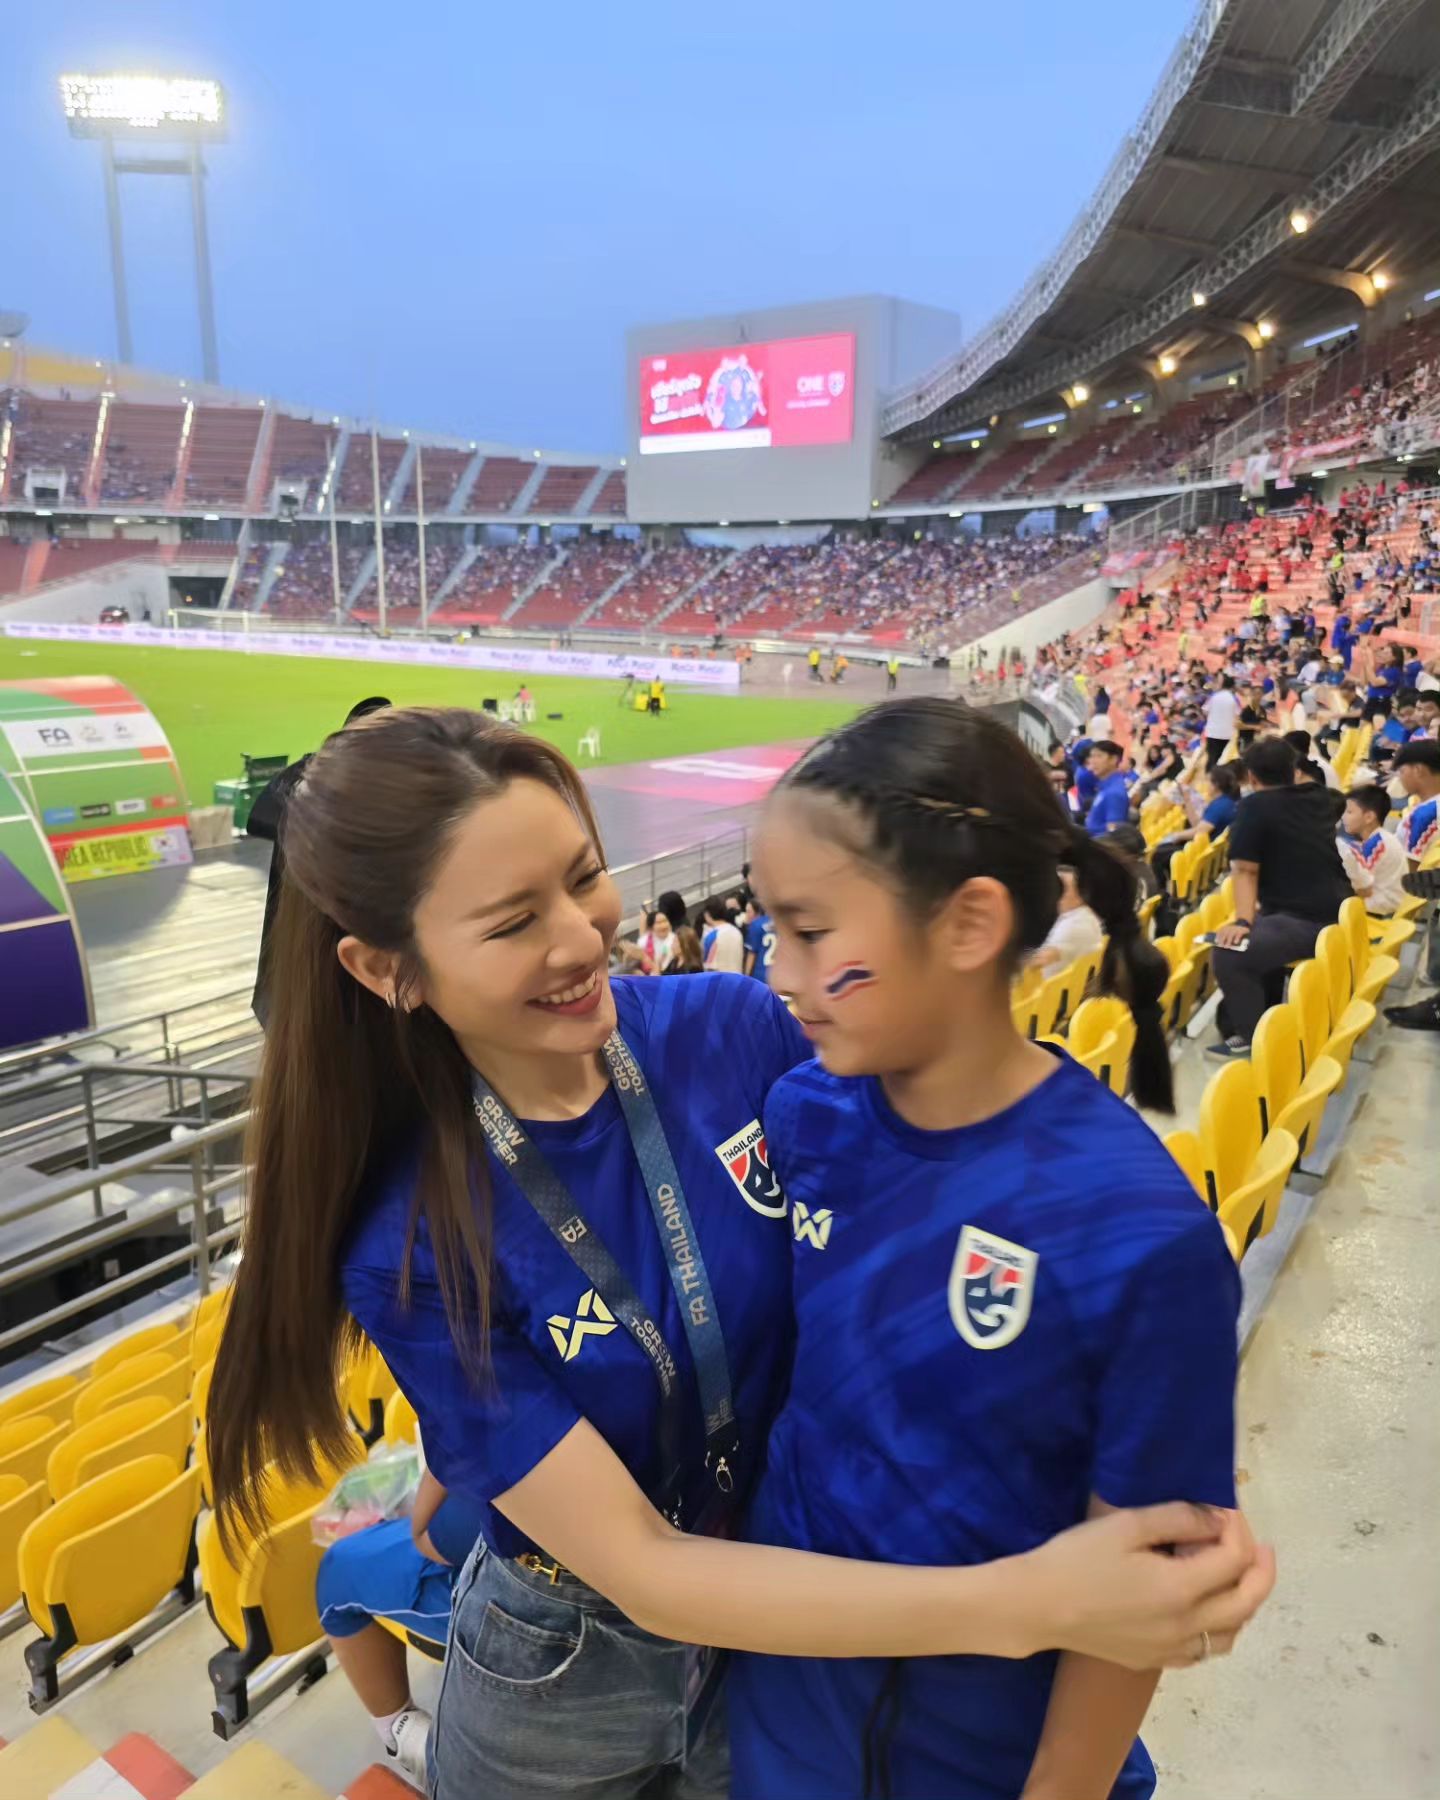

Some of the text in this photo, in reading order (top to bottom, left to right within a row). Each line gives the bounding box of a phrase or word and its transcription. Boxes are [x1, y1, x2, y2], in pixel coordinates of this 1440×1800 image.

[38, 727, 71, 744] FA
[472, 1096, 518, 1166] TOGETHER
[483, 1096, 525, 1146] GROW
[722, 1127, 763, 1161] THAILAND
[657, 1183, 709, 1326] FA THAILAND
